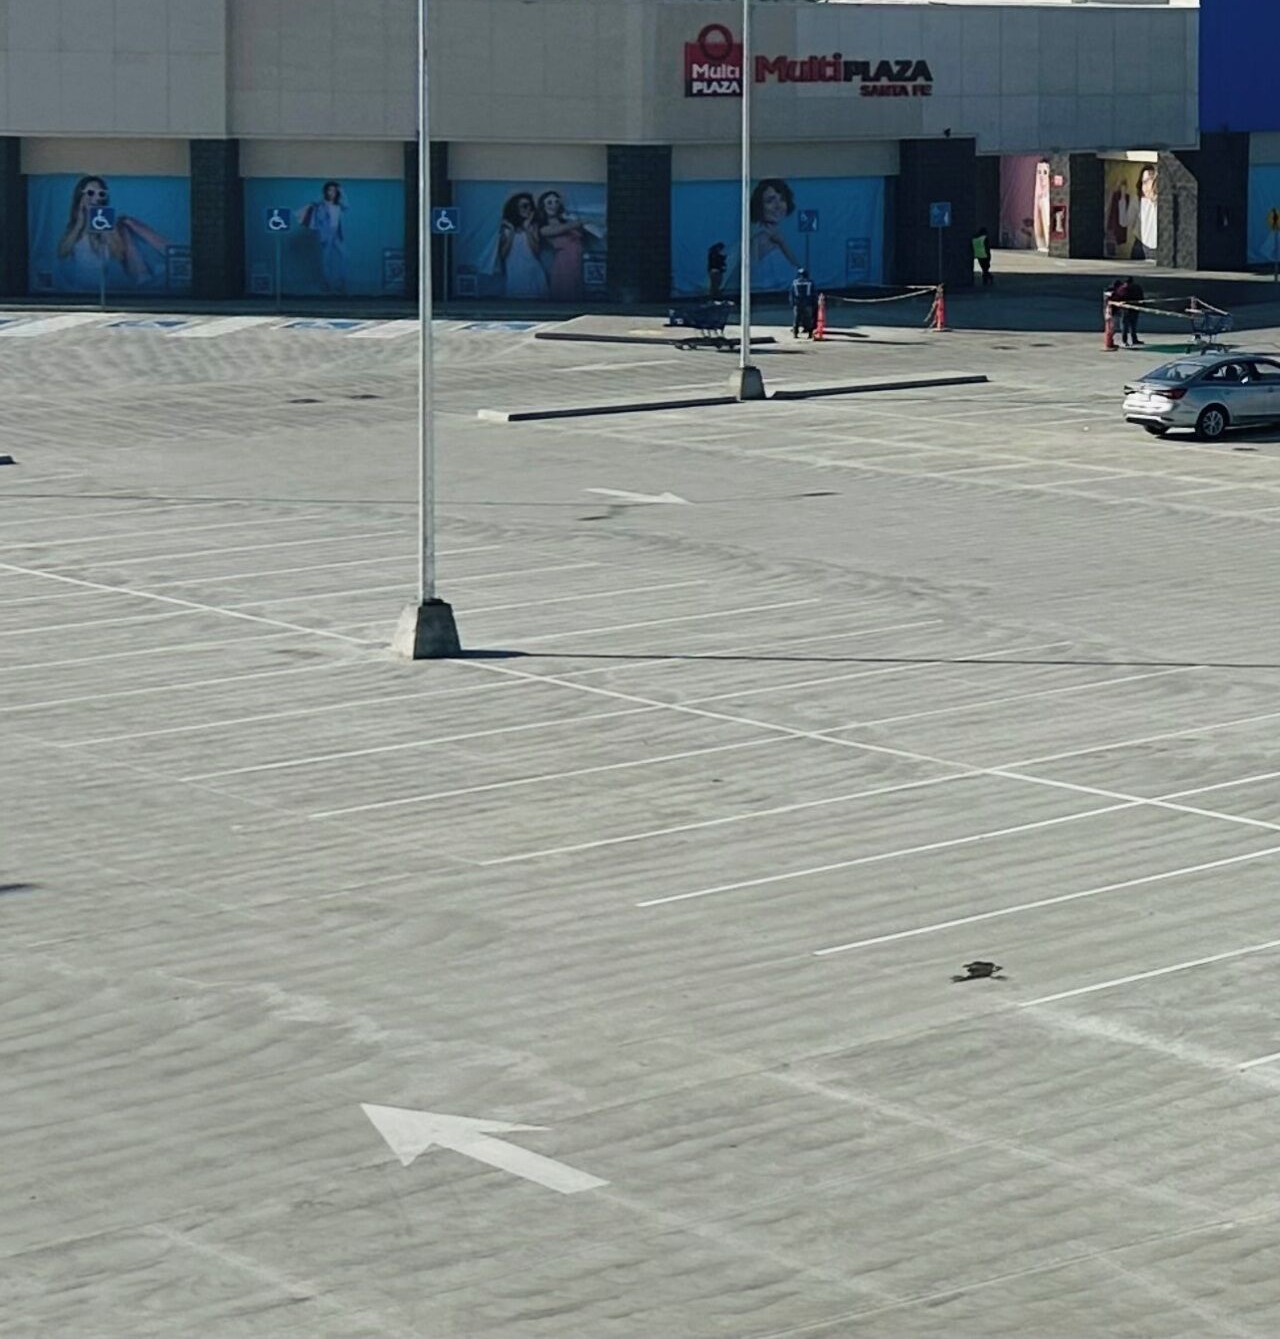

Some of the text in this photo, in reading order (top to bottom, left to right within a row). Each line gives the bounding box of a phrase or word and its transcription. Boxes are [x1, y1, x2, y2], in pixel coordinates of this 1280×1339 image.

[692, 63, 740, 79] Multi
[755, 52, 933, 83] MultiPLAZA
[692, 81, 741, 94] PLAZA
